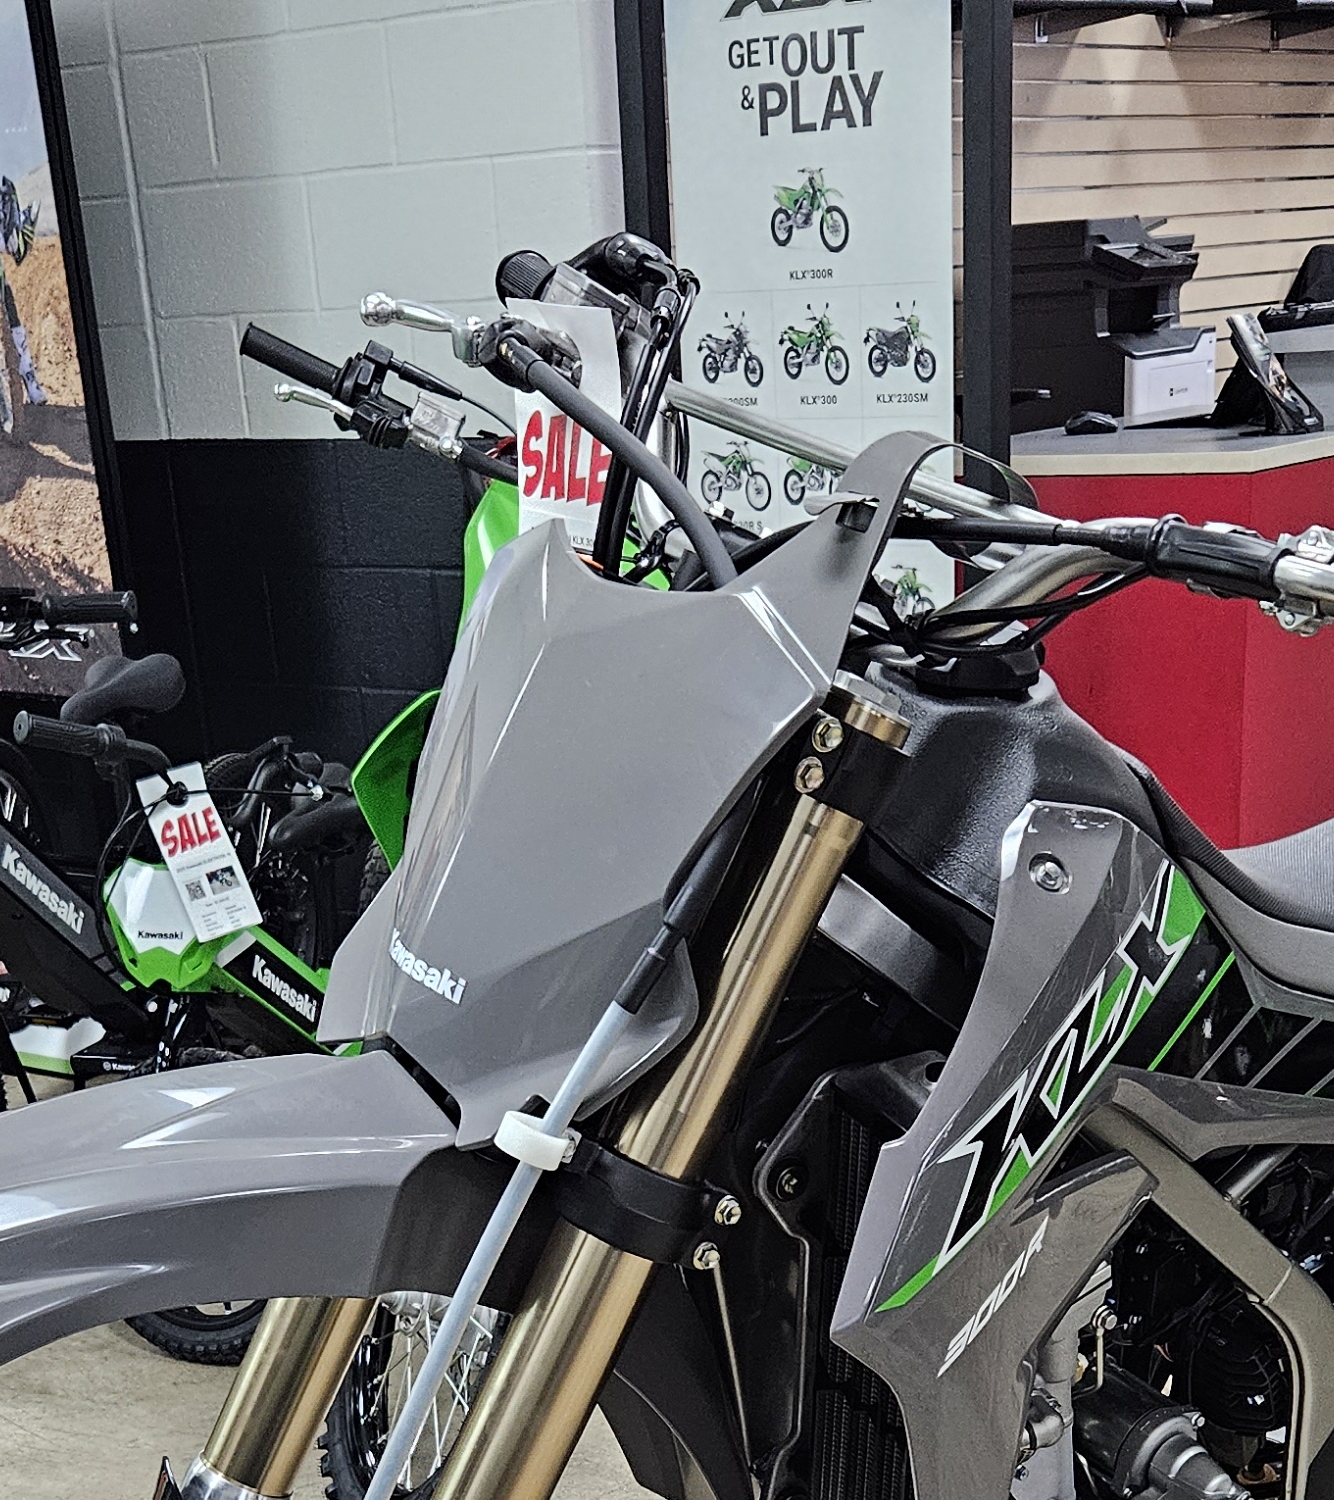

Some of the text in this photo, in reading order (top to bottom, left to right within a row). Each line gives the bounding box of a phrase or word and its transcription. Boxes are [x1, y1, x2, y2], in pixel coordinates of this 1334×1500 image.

[728, 25, 865, 77] GET OUT
[741, 70, 884, 136] & PLAY
[522, 410, 611, 507] SALE
[161, 806, 221, 857] SALE
[1, 843, 84, 935] Kawasaki
[138, 929, 184, 941] Kawasaki
[389, 929, 467, 1005] Kawasaki
[252, 955, 317, 1021] Kawasaki
